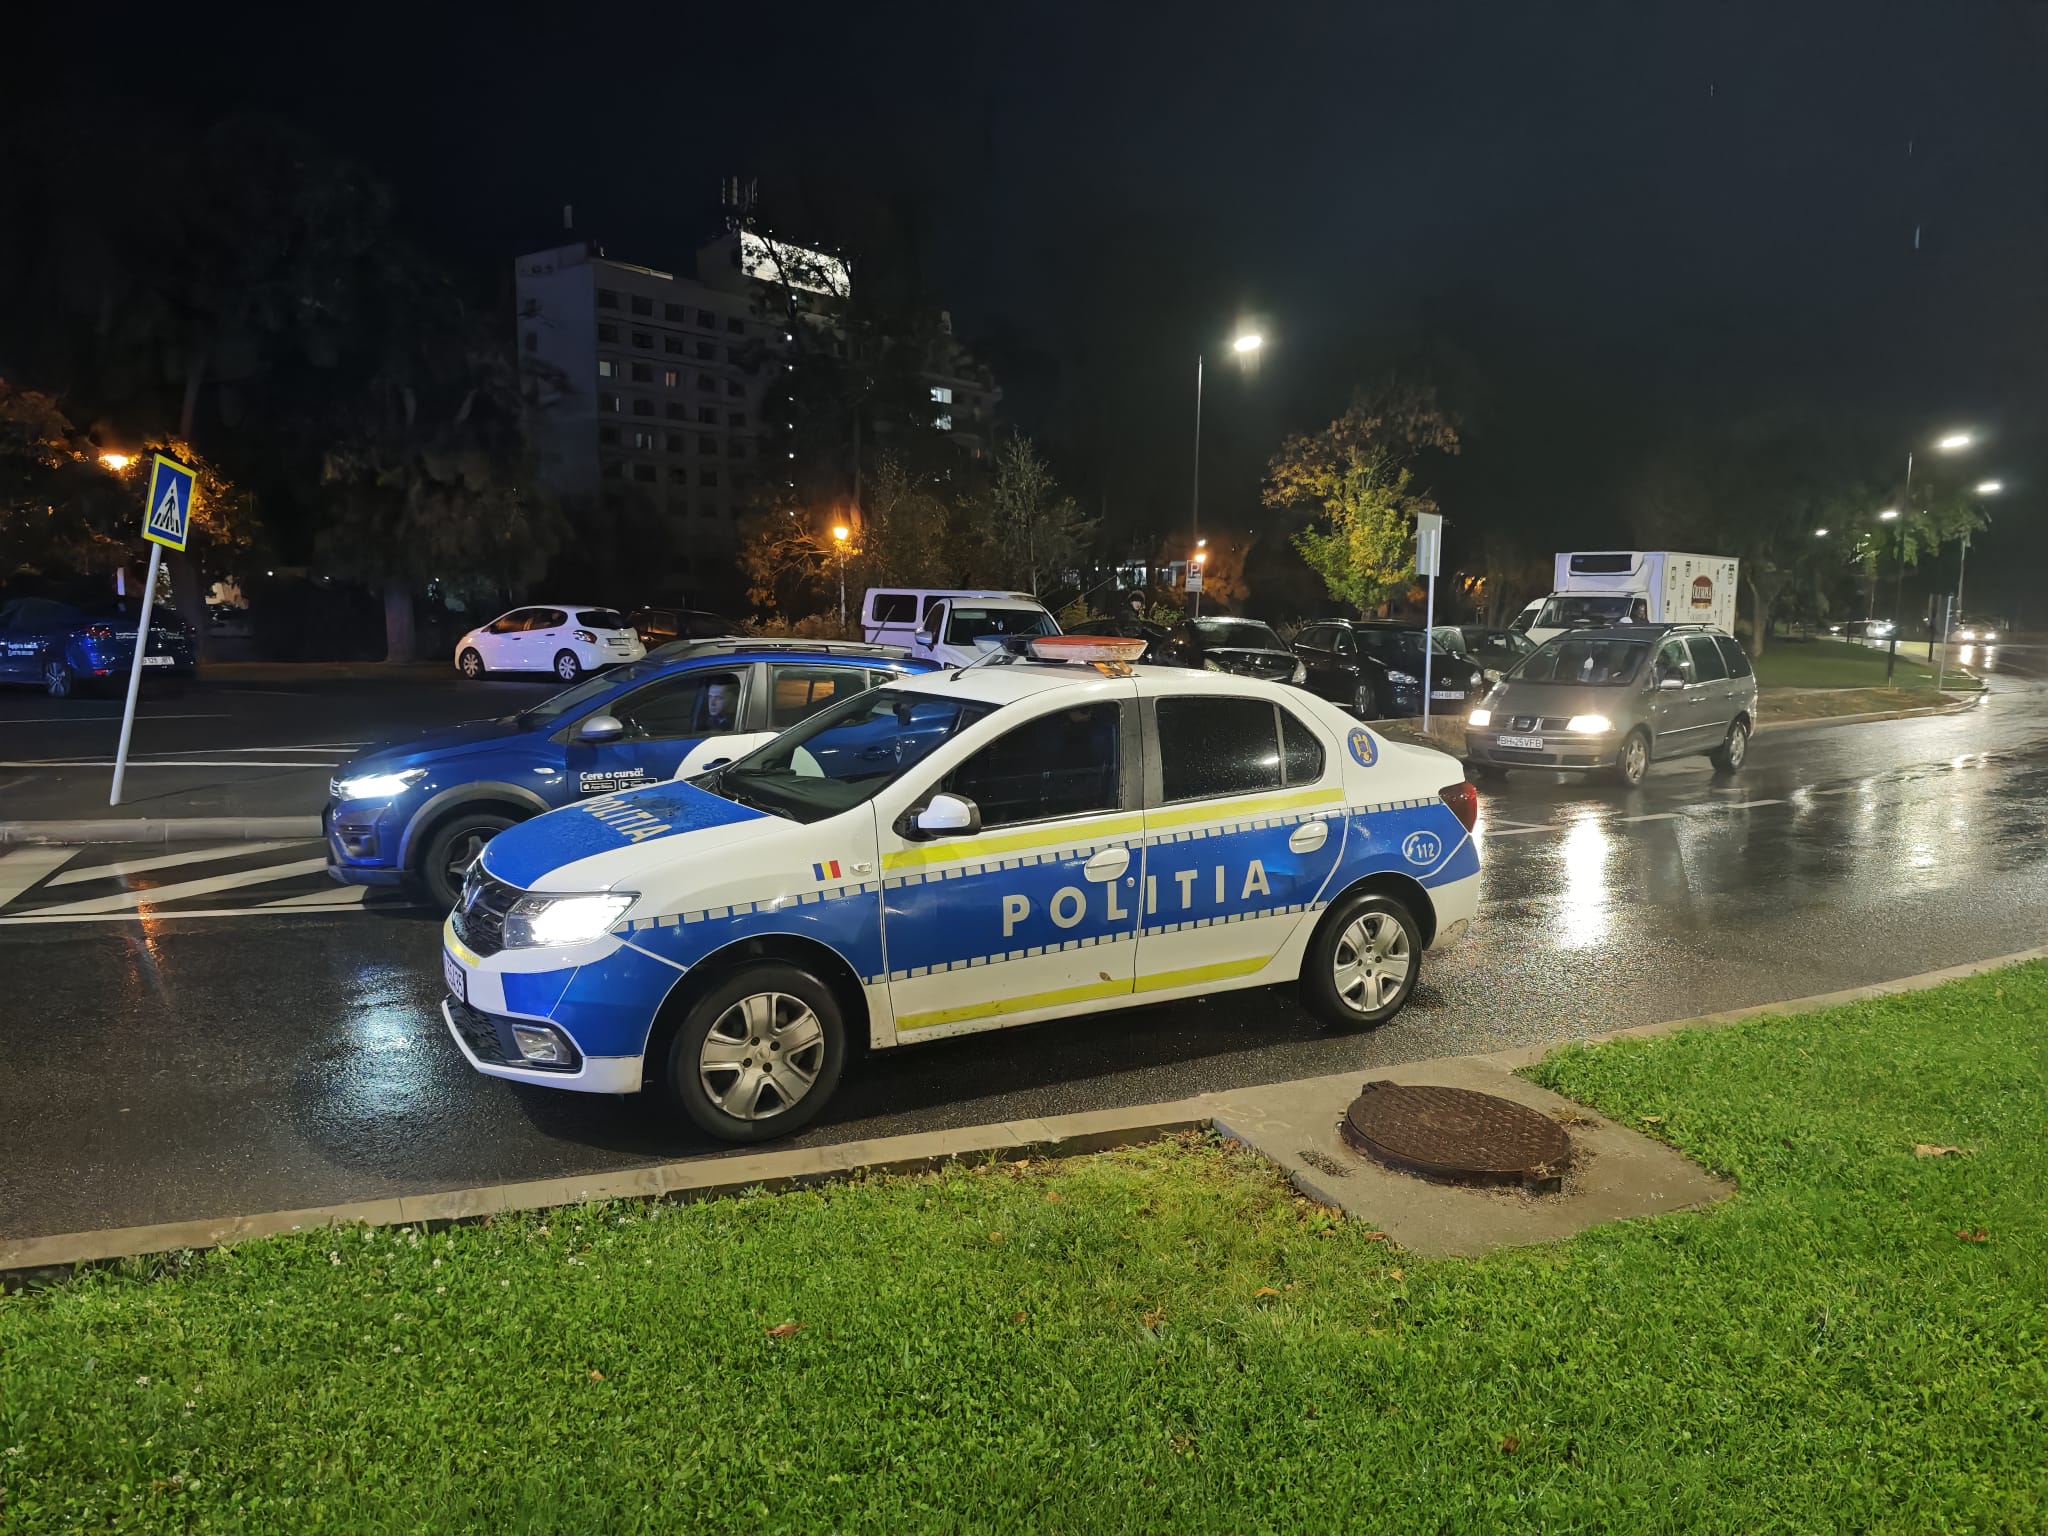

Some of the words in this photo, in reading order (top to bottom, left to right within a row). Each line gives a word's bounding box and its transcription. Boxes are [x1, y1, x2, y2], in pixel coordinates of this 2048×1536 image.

[1190, 562, 1200, 577] P
[580, 772, 603, 780] Cere
[613, 768, 643, 778] cursă!
[1416, 842, 1435, 859] 112
[1002, 859, 1272, 937] POLITIA
